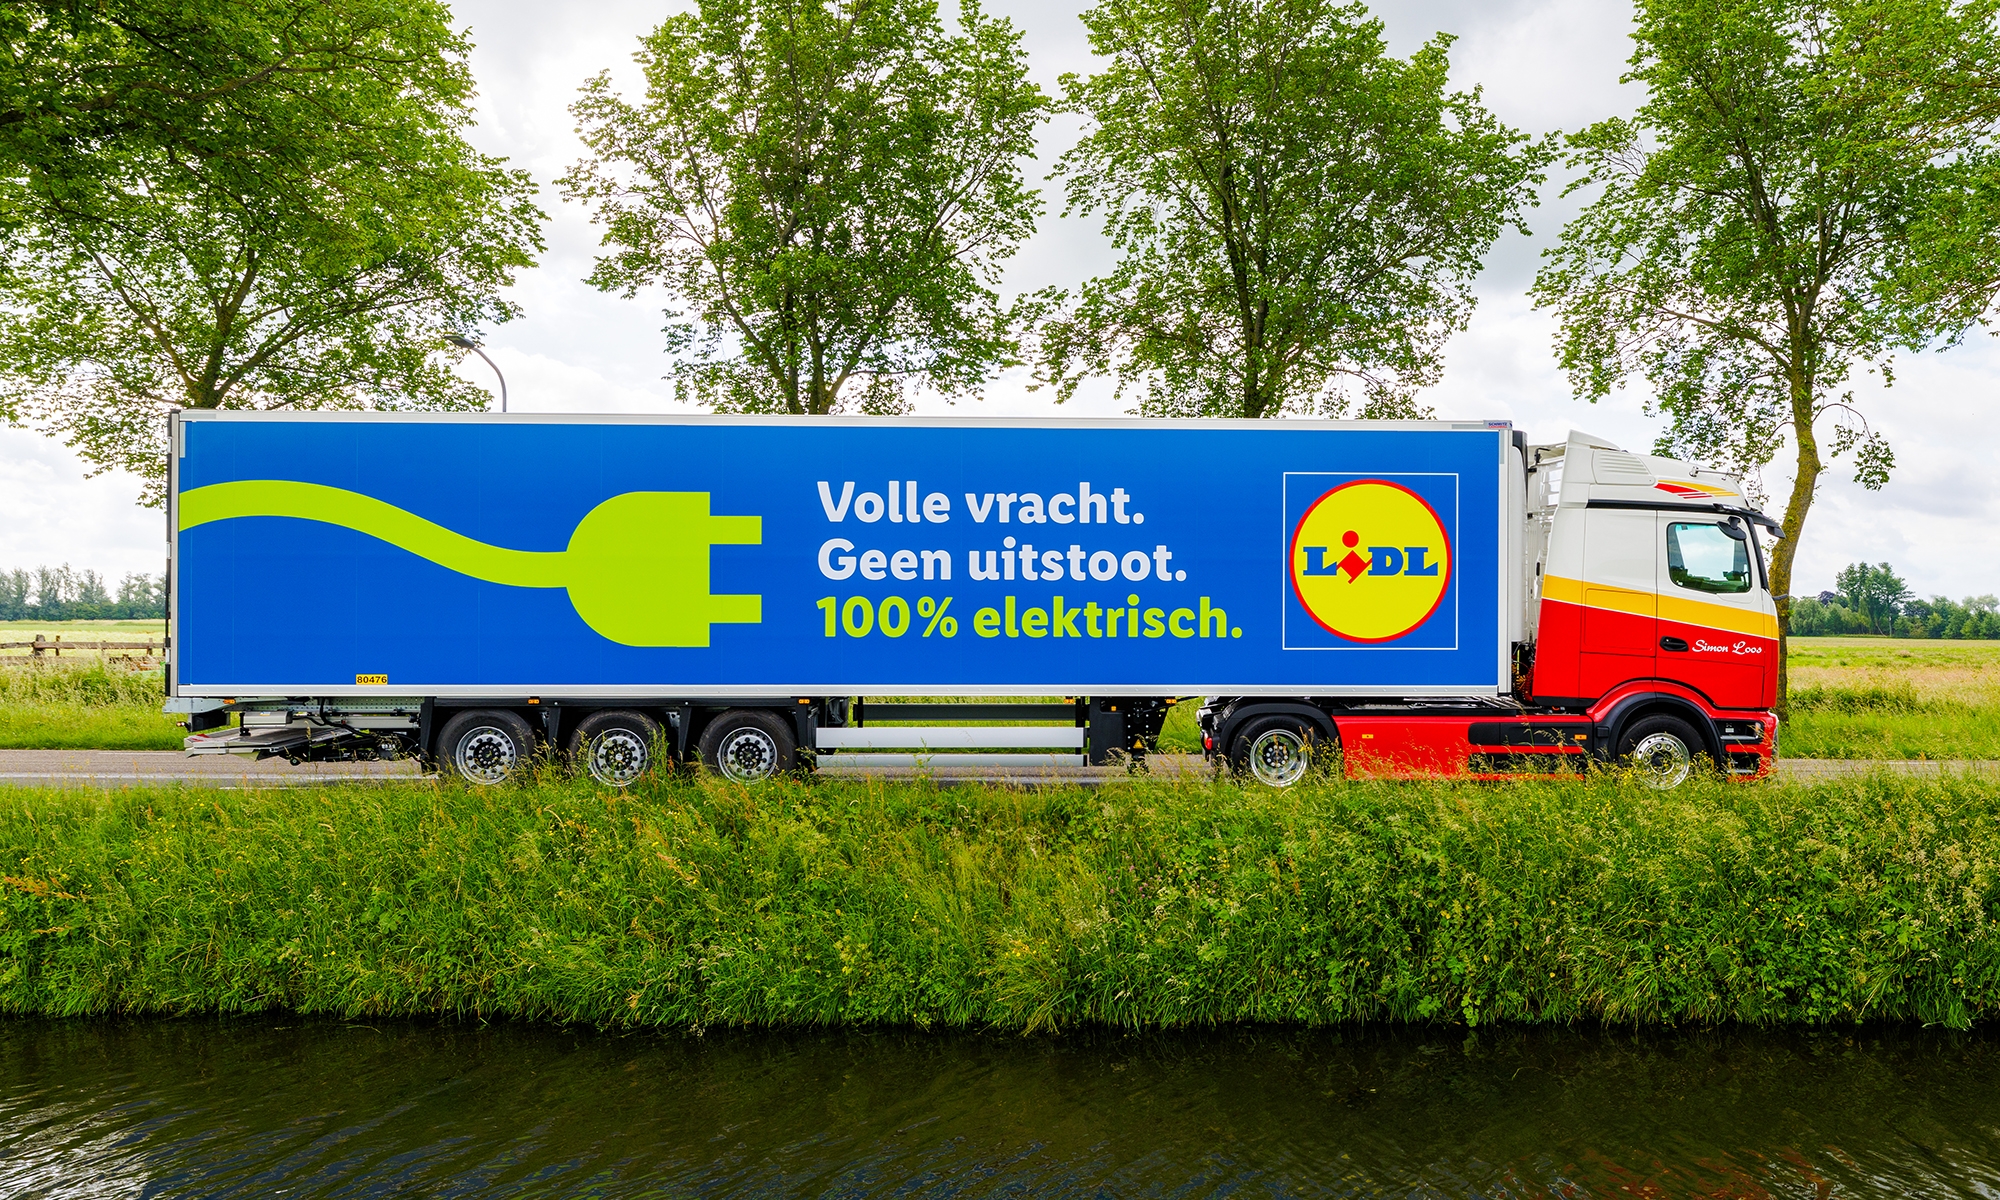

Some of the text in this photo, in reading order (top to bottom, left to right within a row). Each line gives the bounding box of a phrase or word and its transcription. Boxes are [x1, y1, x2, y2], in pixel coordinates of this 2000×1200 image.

[816, 480, 1145, 525] Volle vracht.
[817, 535, 1187, 582] Geen uitstoot.
[973, 593, 1243, 639] elektrisch.
[1692, 639, 1762, 655] Simon Loos
[356, 675, 387, 684] 80476
